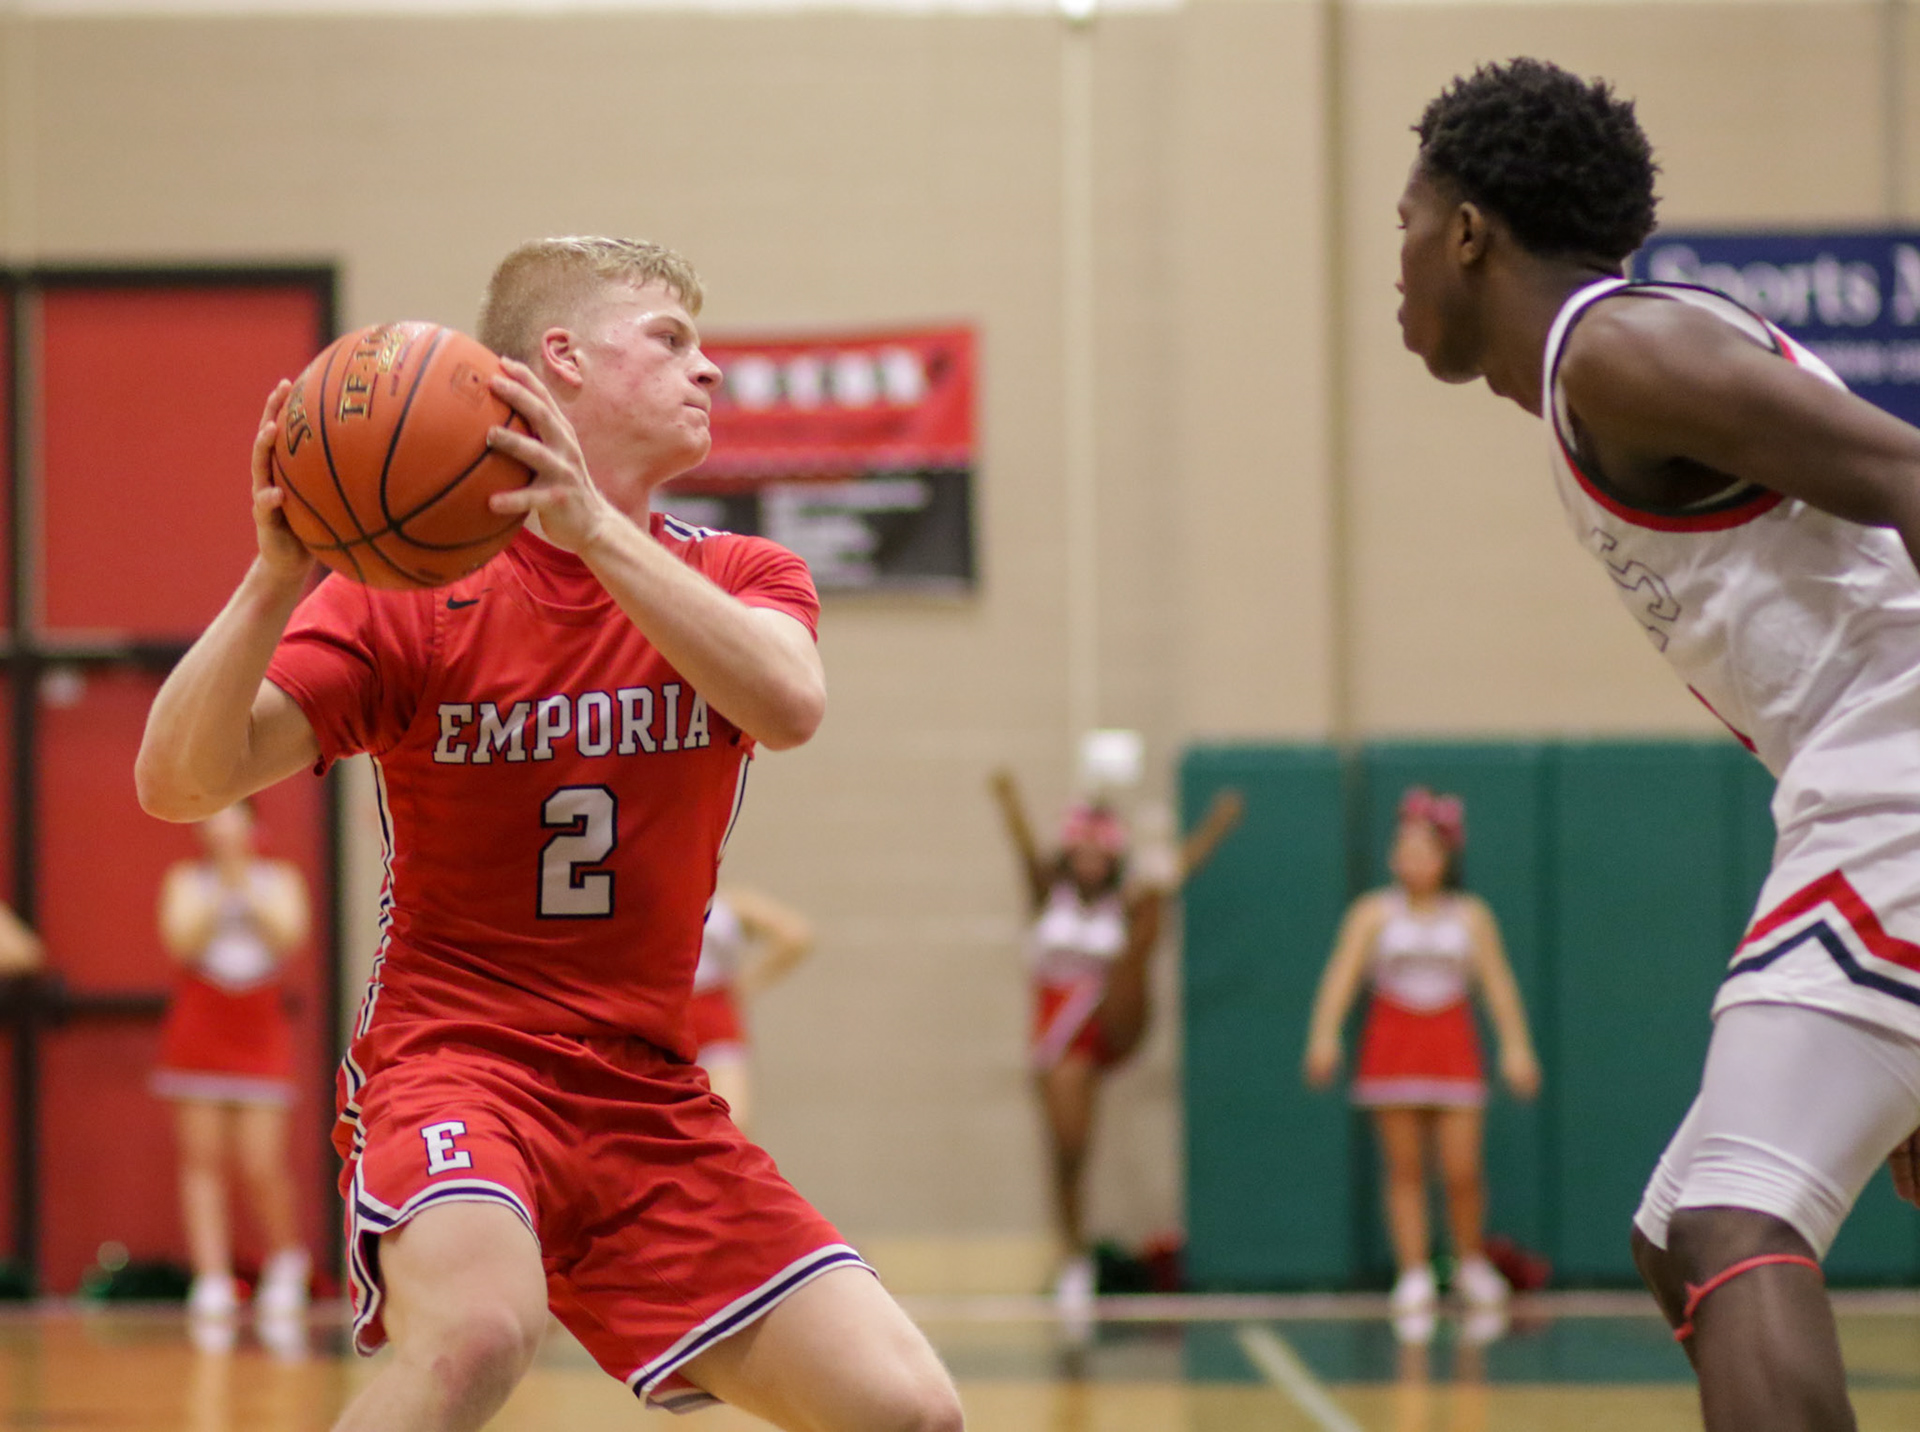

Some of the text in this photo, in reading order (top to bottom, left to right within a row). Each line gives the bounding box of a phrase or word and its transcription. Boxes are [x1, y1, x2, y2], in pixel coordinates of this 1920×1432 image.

[432, 682, 711, 765] EMPORIA
[535, 784, 619, 919] 2
[420, 1120, 474, 1177] E
